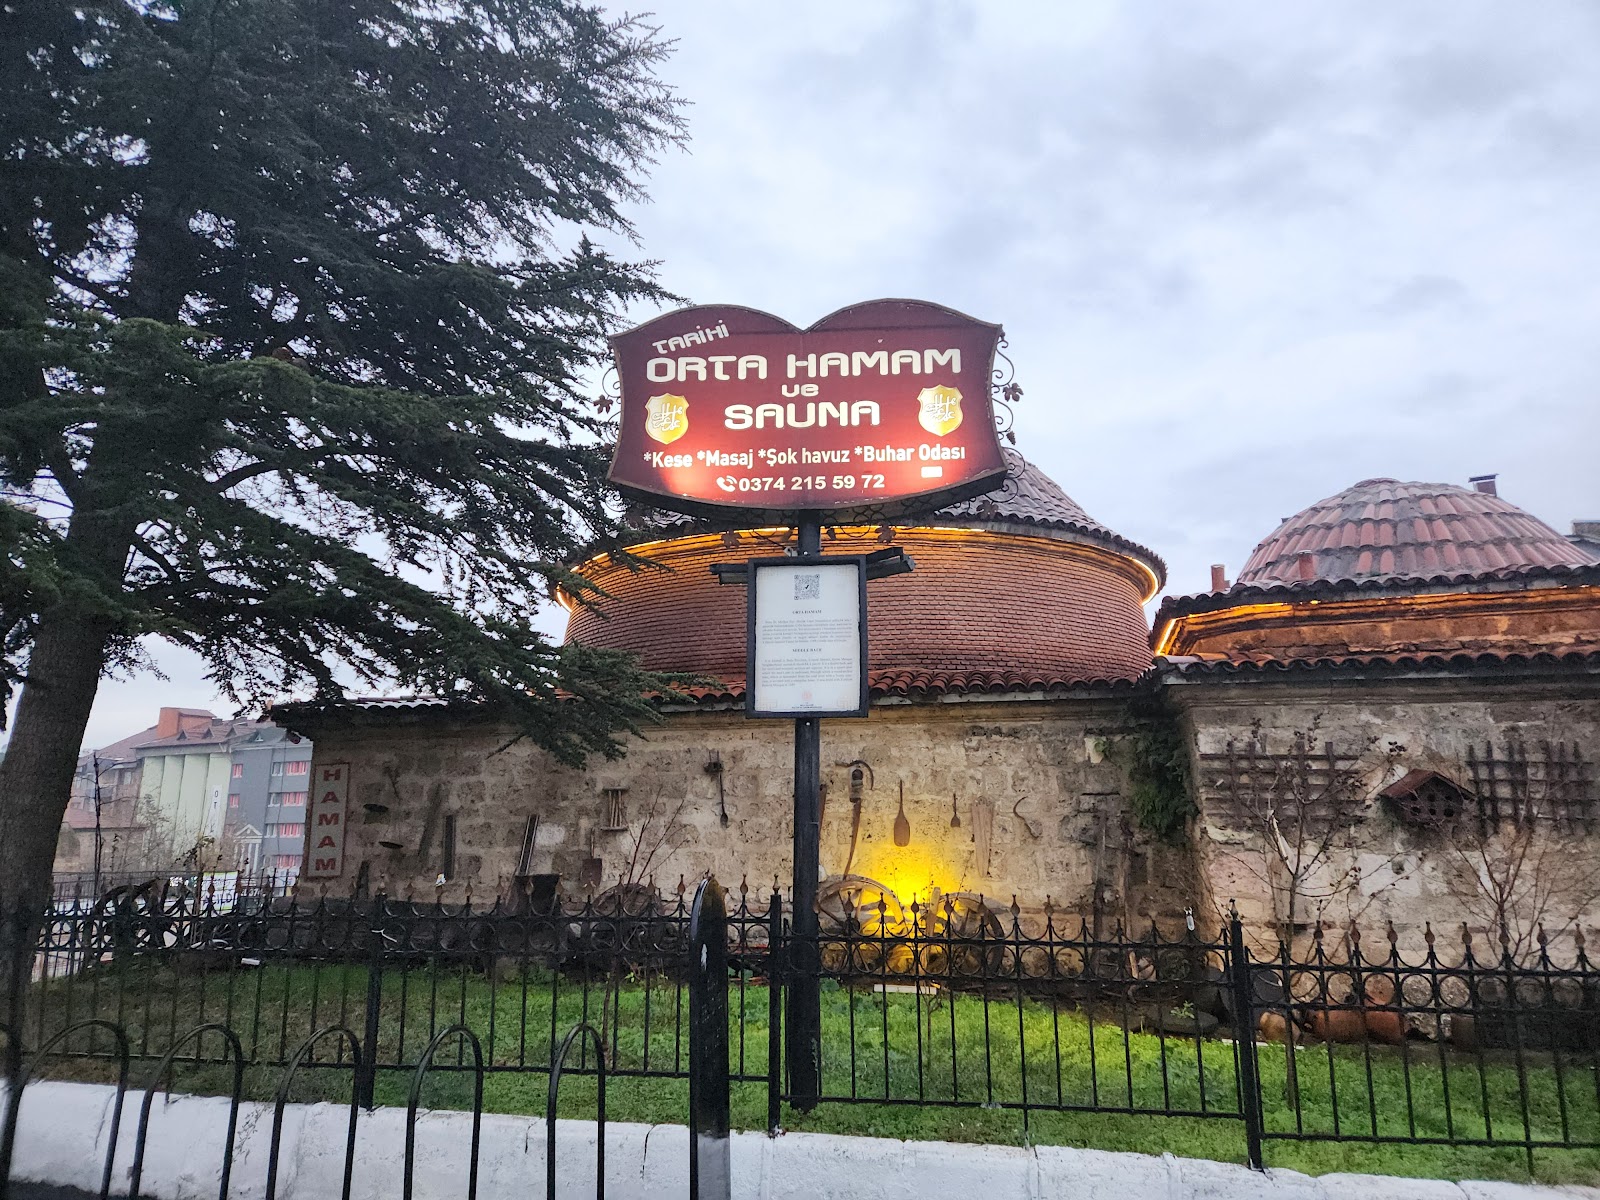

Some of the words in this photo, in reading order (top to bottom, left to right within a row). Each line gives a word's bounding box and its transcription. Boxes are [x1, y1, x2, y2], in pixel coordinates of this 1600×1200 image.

[652, 319, 730, 354] TARİHİ
[646, 354, 768, 383] ORTA
[786, 348, 962, 379] HAMAM
[724, 400, 880, 430] SAUNA
[801, 447, 850, 464] havuz
[918, 443, 966, 461] Odası
[738, 476, 786, 492] 0374
[790, 475, 826, 491] 215
[831, 474, 856, 490] 59
[861, 473, 885, 489] 72
[315, 768, 341, 871] HAMAM
